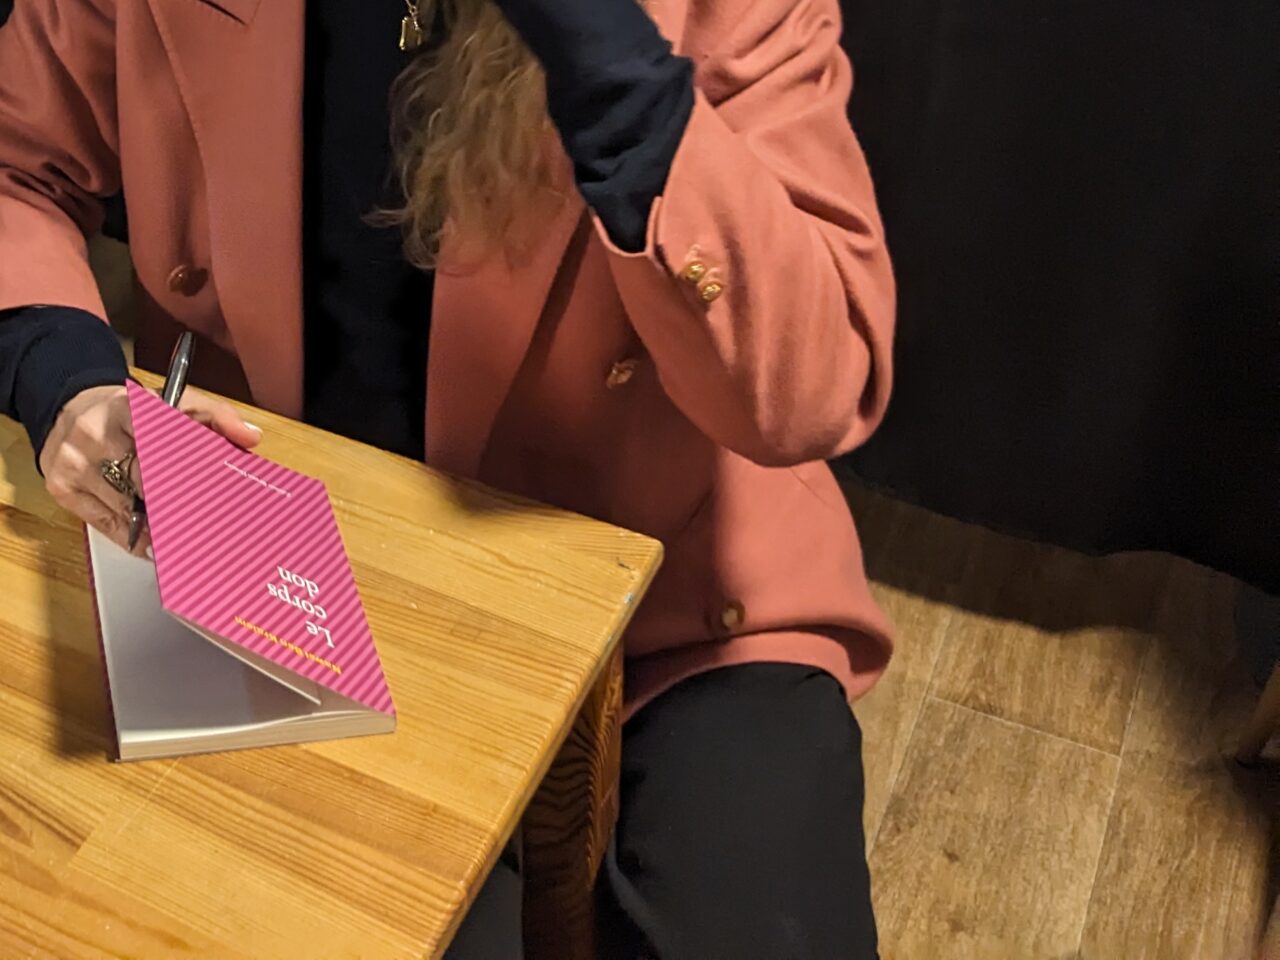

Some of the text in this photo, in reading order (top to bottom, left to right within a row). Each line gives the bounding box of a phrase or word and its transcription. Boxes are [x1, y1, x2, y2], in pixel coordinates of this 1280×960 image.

[277, 565, 320, 599] don
[267, 583, 328, 620] corps
[305, 621, 336, 649] Le
